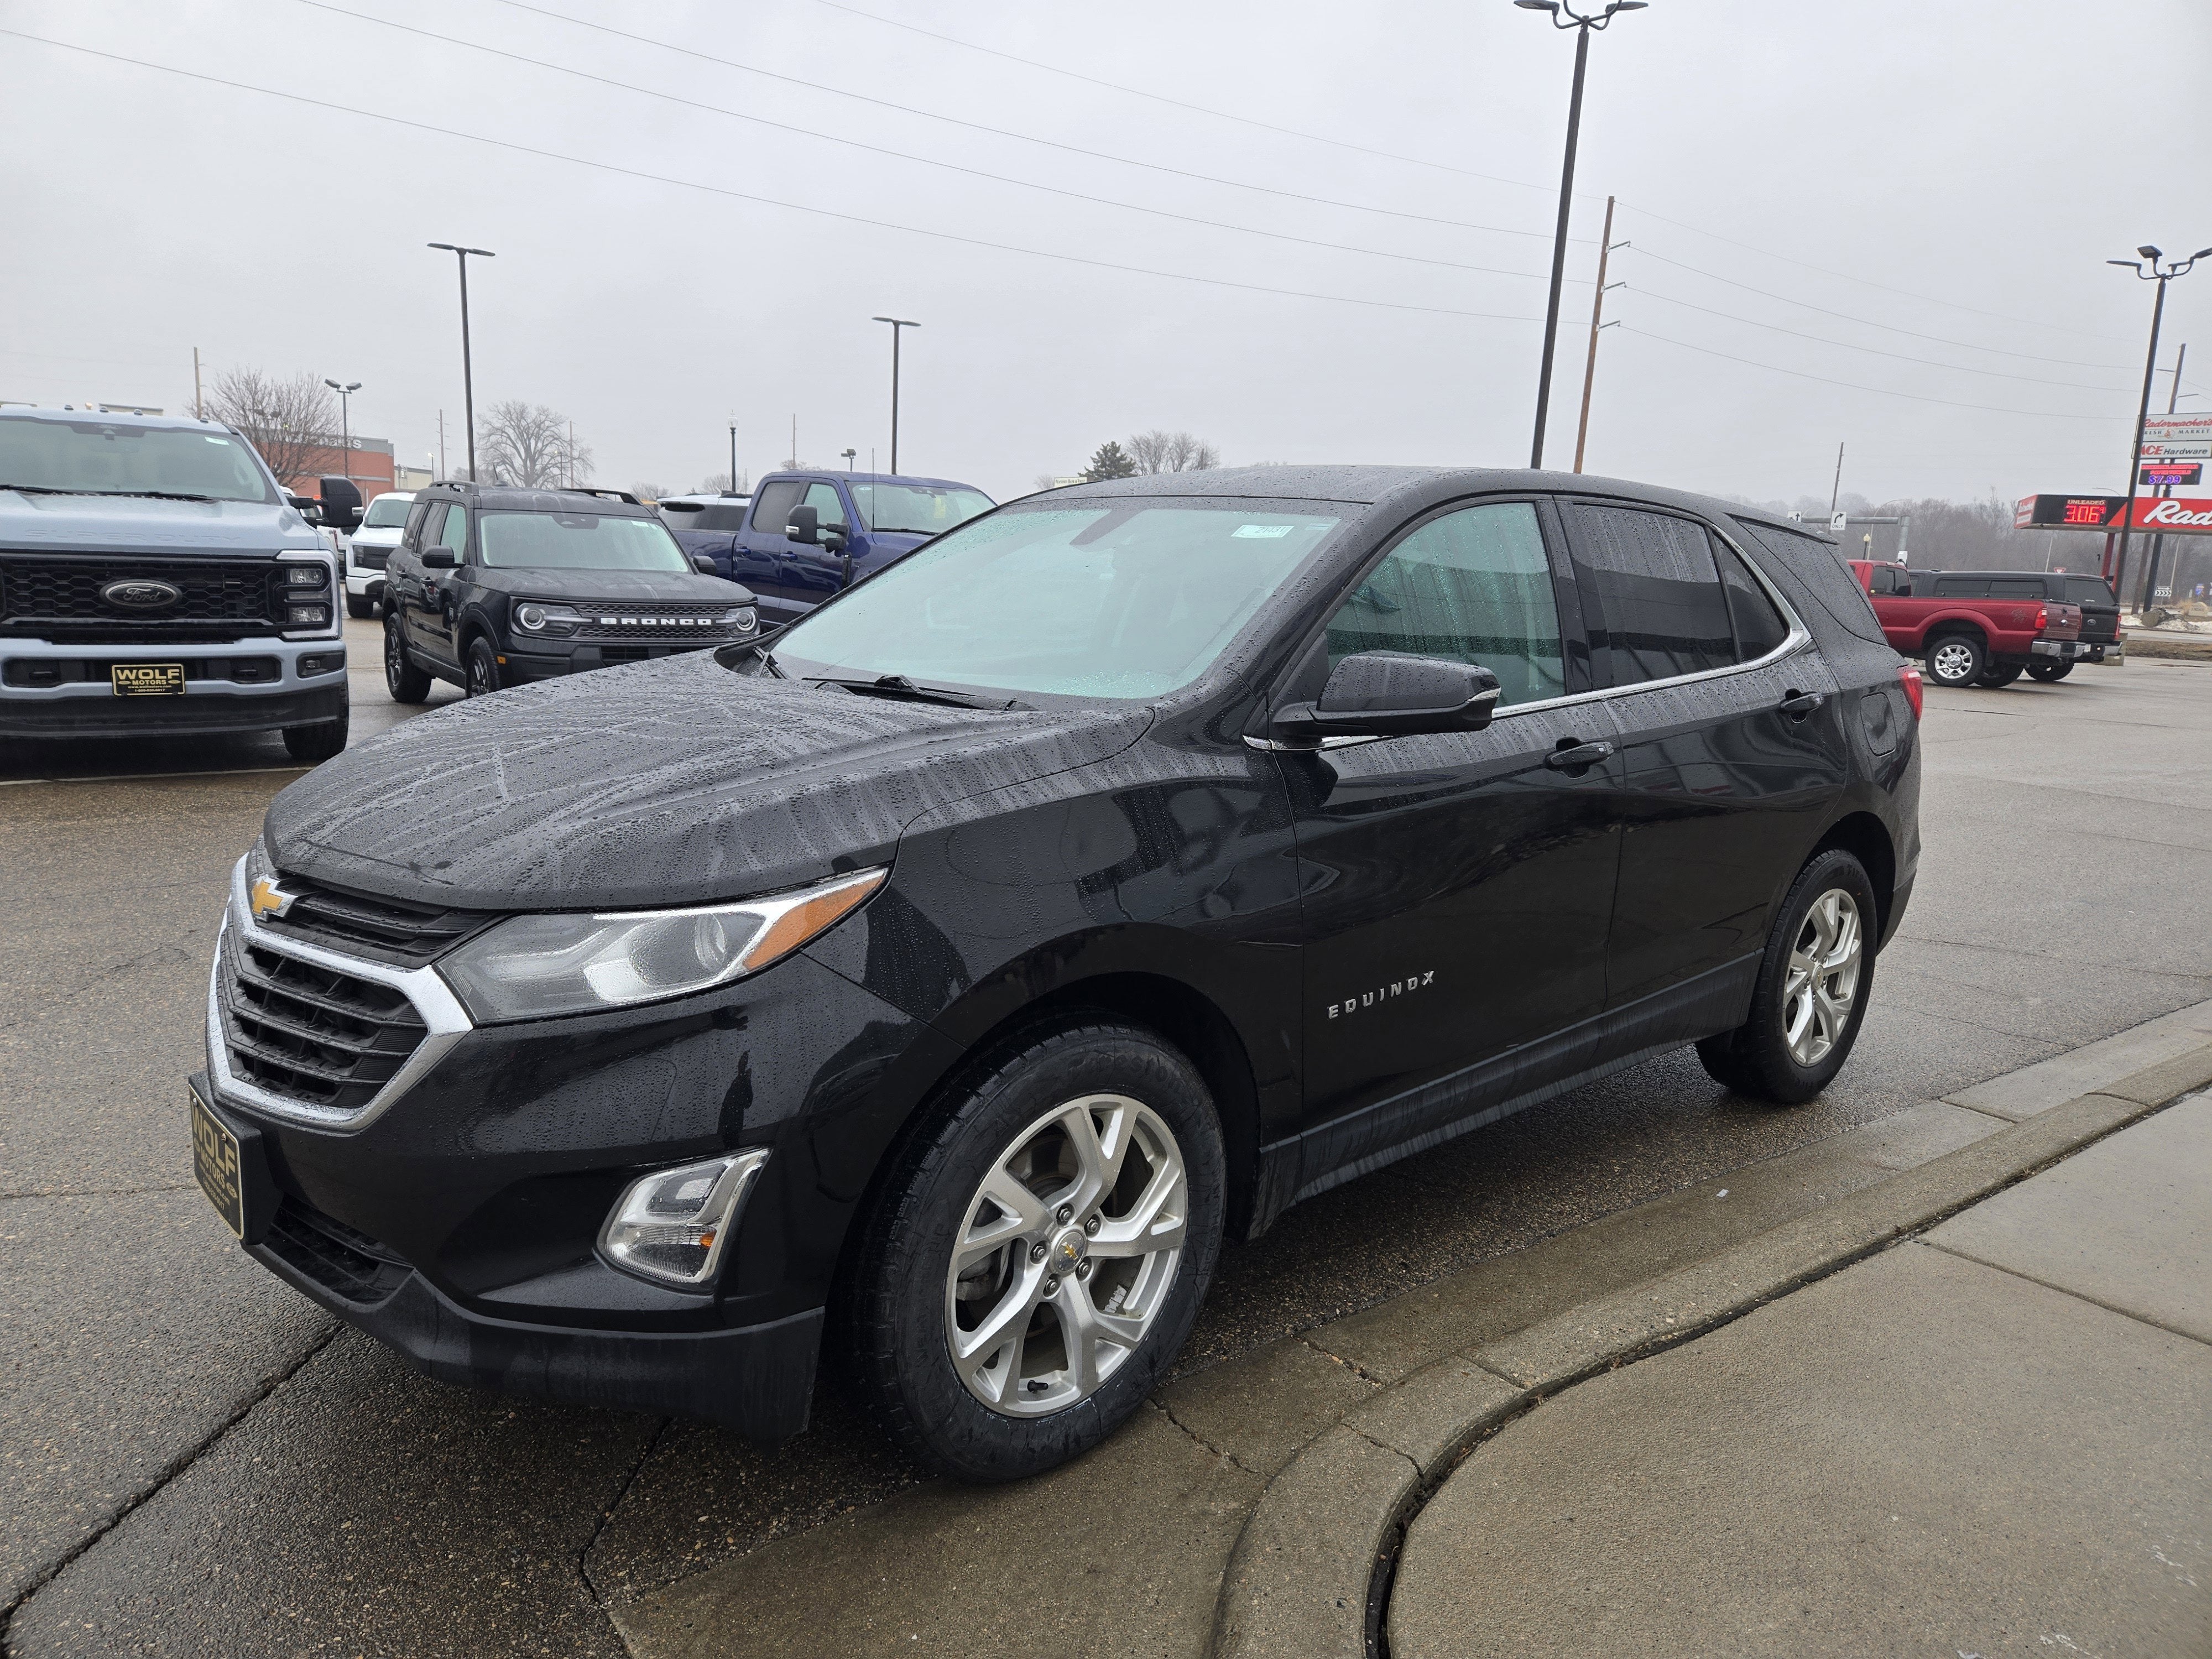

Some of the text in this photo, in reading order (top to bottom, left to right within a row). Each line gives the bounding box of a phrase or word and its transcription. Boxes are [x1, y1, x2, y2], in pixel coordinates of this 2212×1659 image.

[2163, 447, 2208, 456] Hardware
[2148, 475, 2182, 484] $7.99
[123, 587, 161, 601] Ford
[117, 669, 180, 680] WOLF
[1328, 971, 1434, 1019] EQUINOX
[191, 1099, 236, 1177] WOLF
[200, 1145, 226, 1190] MOTORS
